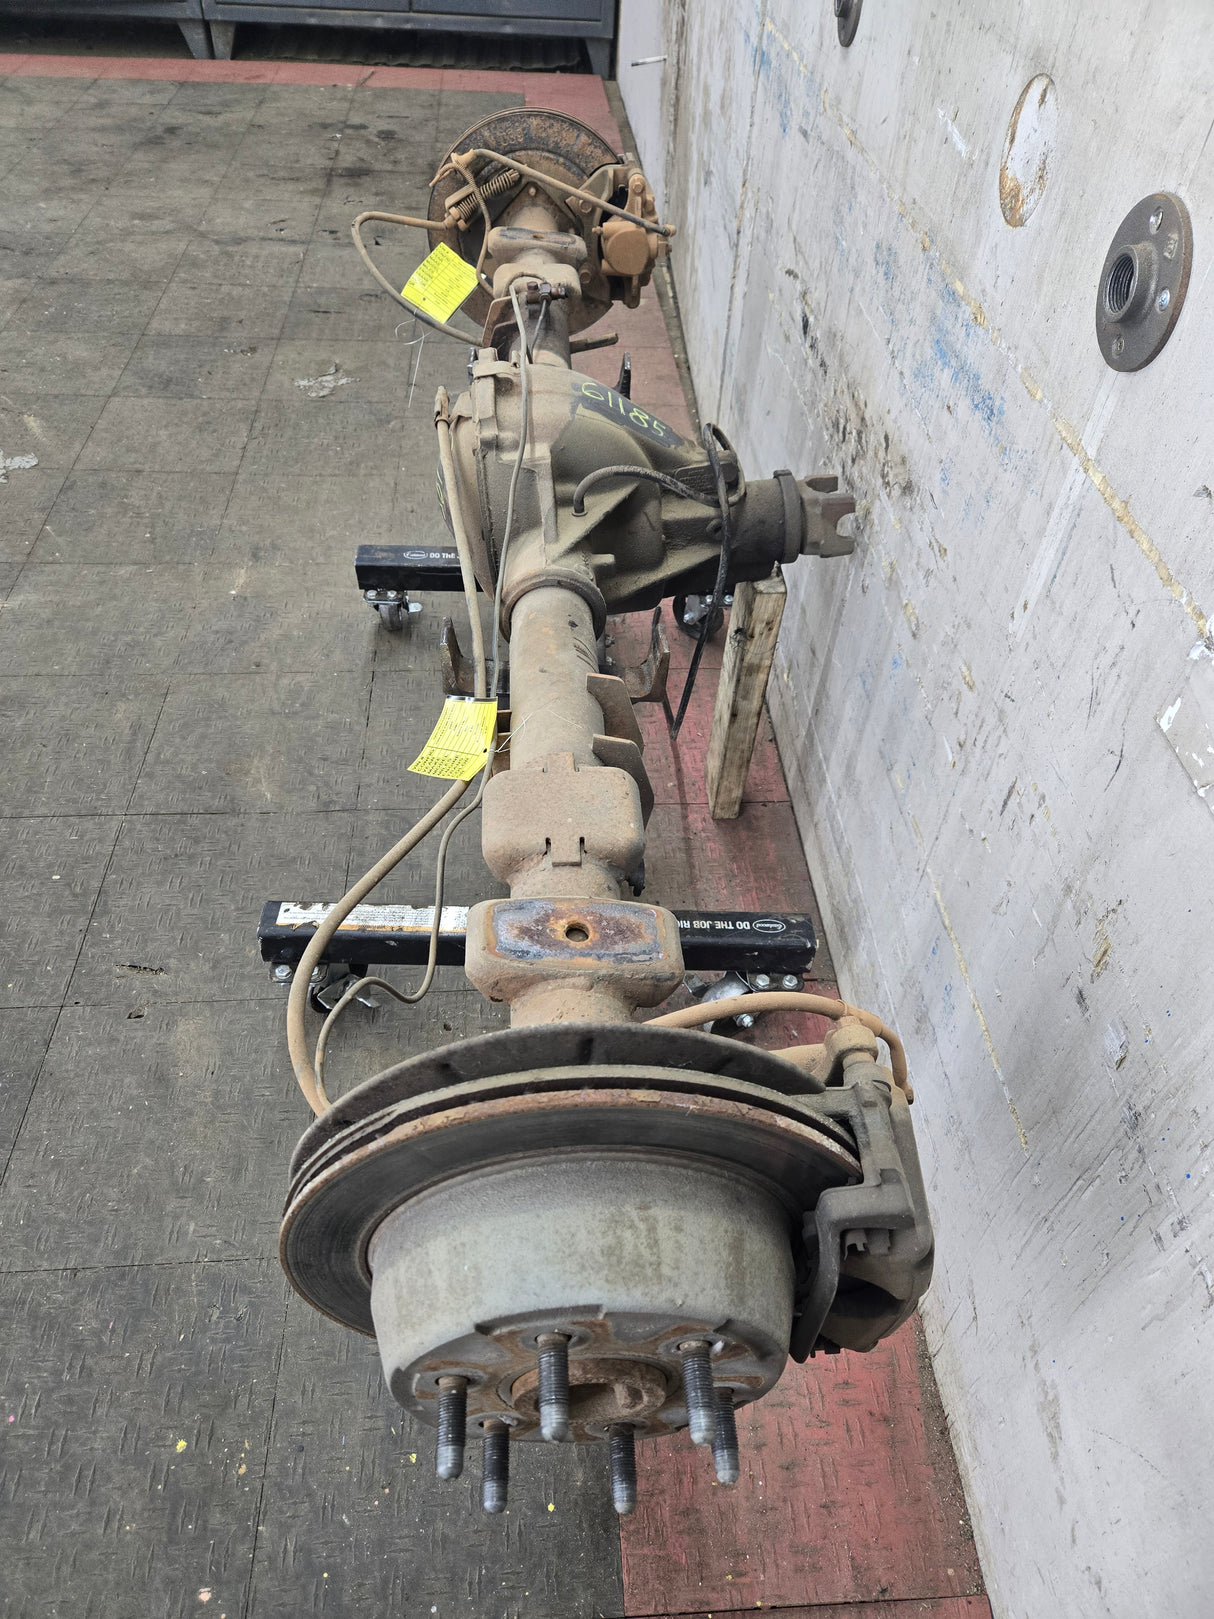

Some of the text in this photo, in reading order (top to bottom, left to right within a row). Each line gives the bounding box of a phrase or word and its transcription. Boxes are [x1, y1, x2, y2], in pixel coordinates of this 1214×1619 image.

[581, 381, 666, 437] 61185
[693, 920, 712, 929] JOB
[714, 920, 733, 930] THE
[736, 921, 751, 930] DO
